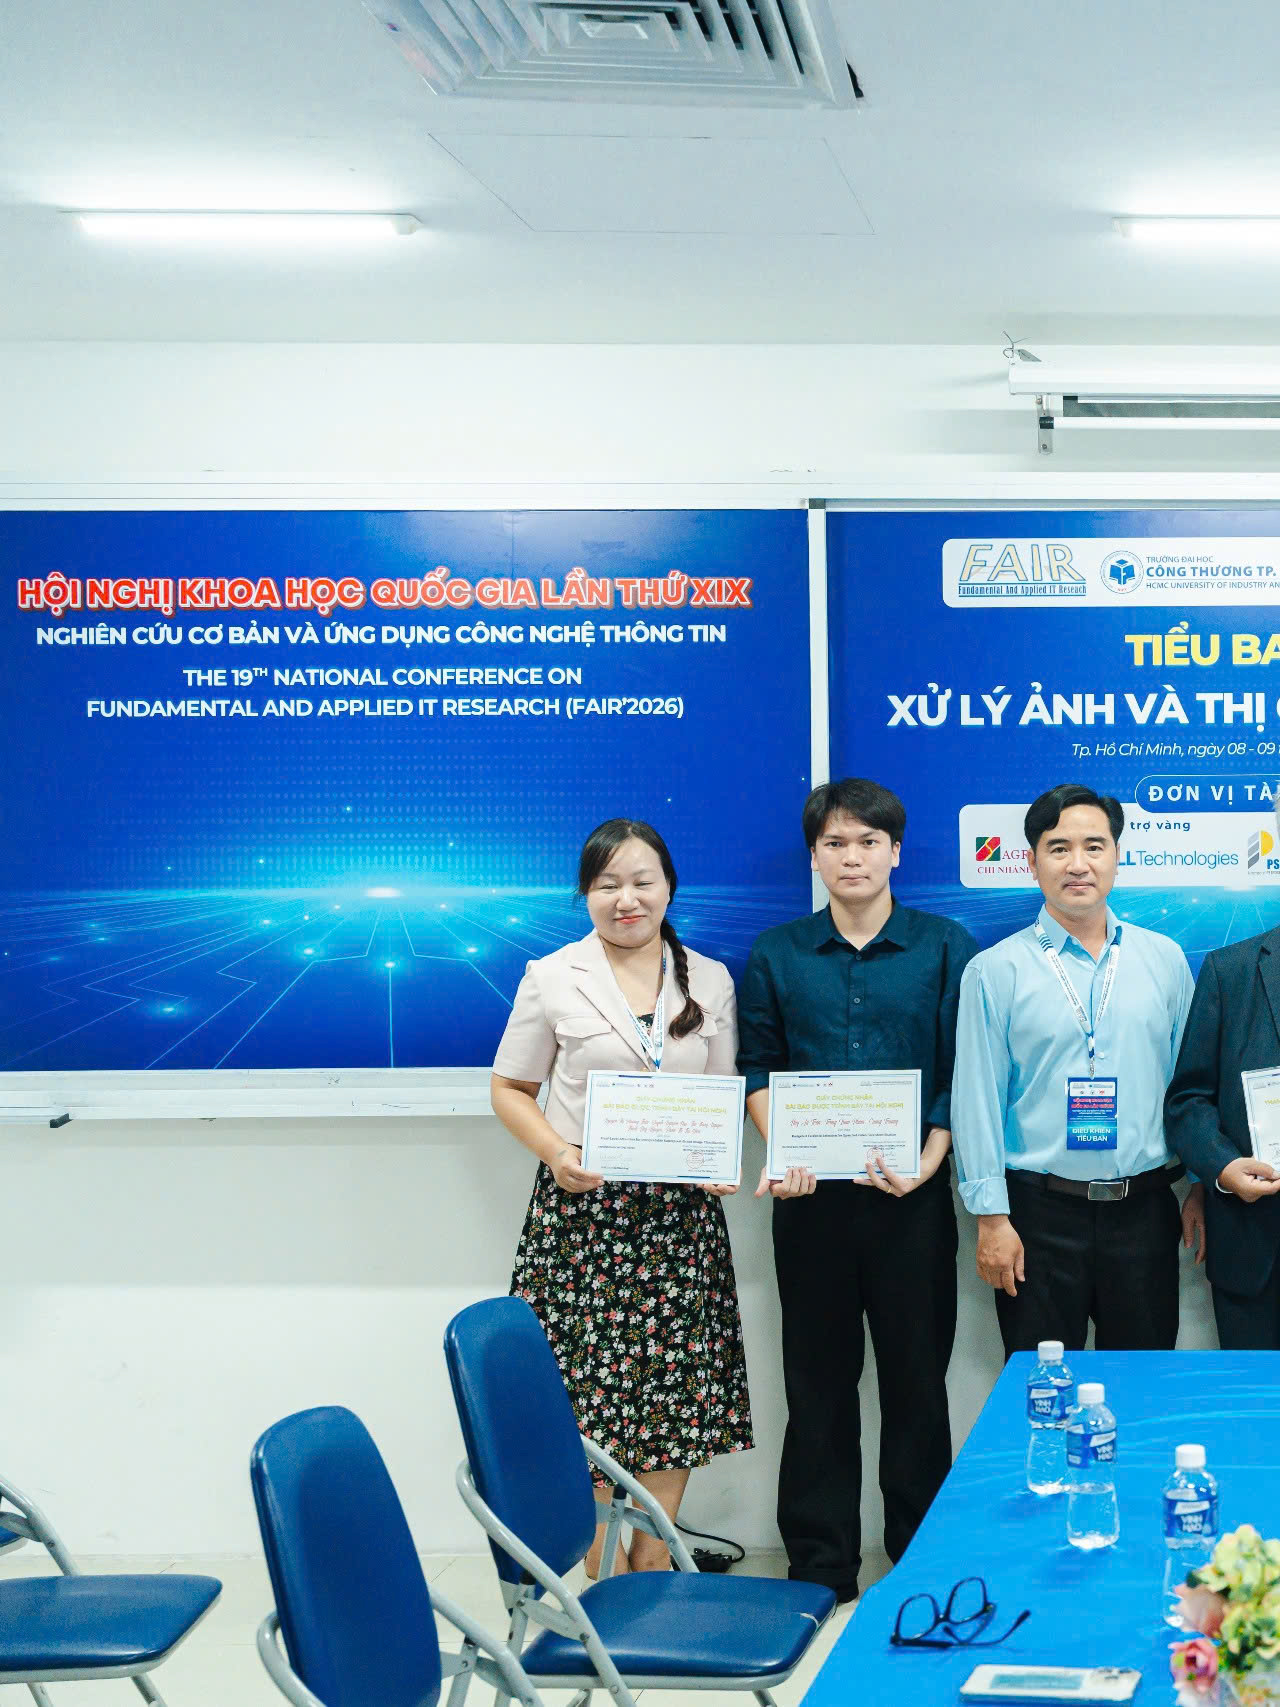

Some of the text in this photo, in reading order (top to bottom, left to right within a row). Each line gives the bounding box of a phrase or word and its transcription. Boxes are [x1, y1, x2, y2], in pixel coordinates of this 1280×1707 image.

[958, 544, 1086, 582] FAIR
[1146, 564, 1187, 577] CÔNG
[1190, 565, 1253, 577] THƯƠNG
[1256, 566, 1277, 577] TP.
[17, 567, 751, 617] HỘI NGHỊ KHOA HỌC QUỐC GIA LẦN THỨ XIX
[37, 621, 726, 649] NGHIÊN CỨU CƠ BẢN VÀ ỨNG DỤNG CÔNG NGHỆ THÔNG TIN
[1124, 622, 1220, 666] TIỂU
[183, 669, 228, 687] THE
[273, 668, 389, 687] NATIONAL
[392, 668, 544, 686] CONFERENCE
[547, 668, 582, 685] ON
[87, 700, 259, 718] FUNDAMENTAL
[261, 700, 313, 717] AND
[317, 699, 414, 716] APPLIED
[418, 699, 439, 716] IT
[443, 698, 560, 716] RESEARCH
[886, 682, 952, 727] XỬ
[960, 685, 1013, 726] LÝ
[1018, 682, 1115, 726] ẢNH
[1123, 684, 1190, 726] VÀ
[1195, 691, 1266, 733] THỊ
[1072, 743, 1092, 759] Tp.
[1095, 742, 1117, 756] Hồ
[1118, 742, 1143, 756] Chí
[1145, 742, 1184, 758] Minh,
[1187, 742, 1225, 758] ngày
[1227, 742, 1247, 755] 08
[1256, 742, 1276, 755] 09
[1148, 781, 1274, 806] ĐƠN VỊ TÀ
[1130, 820, 1191, 832] trợ vàng
[977, 866, 995, 874] CHI
